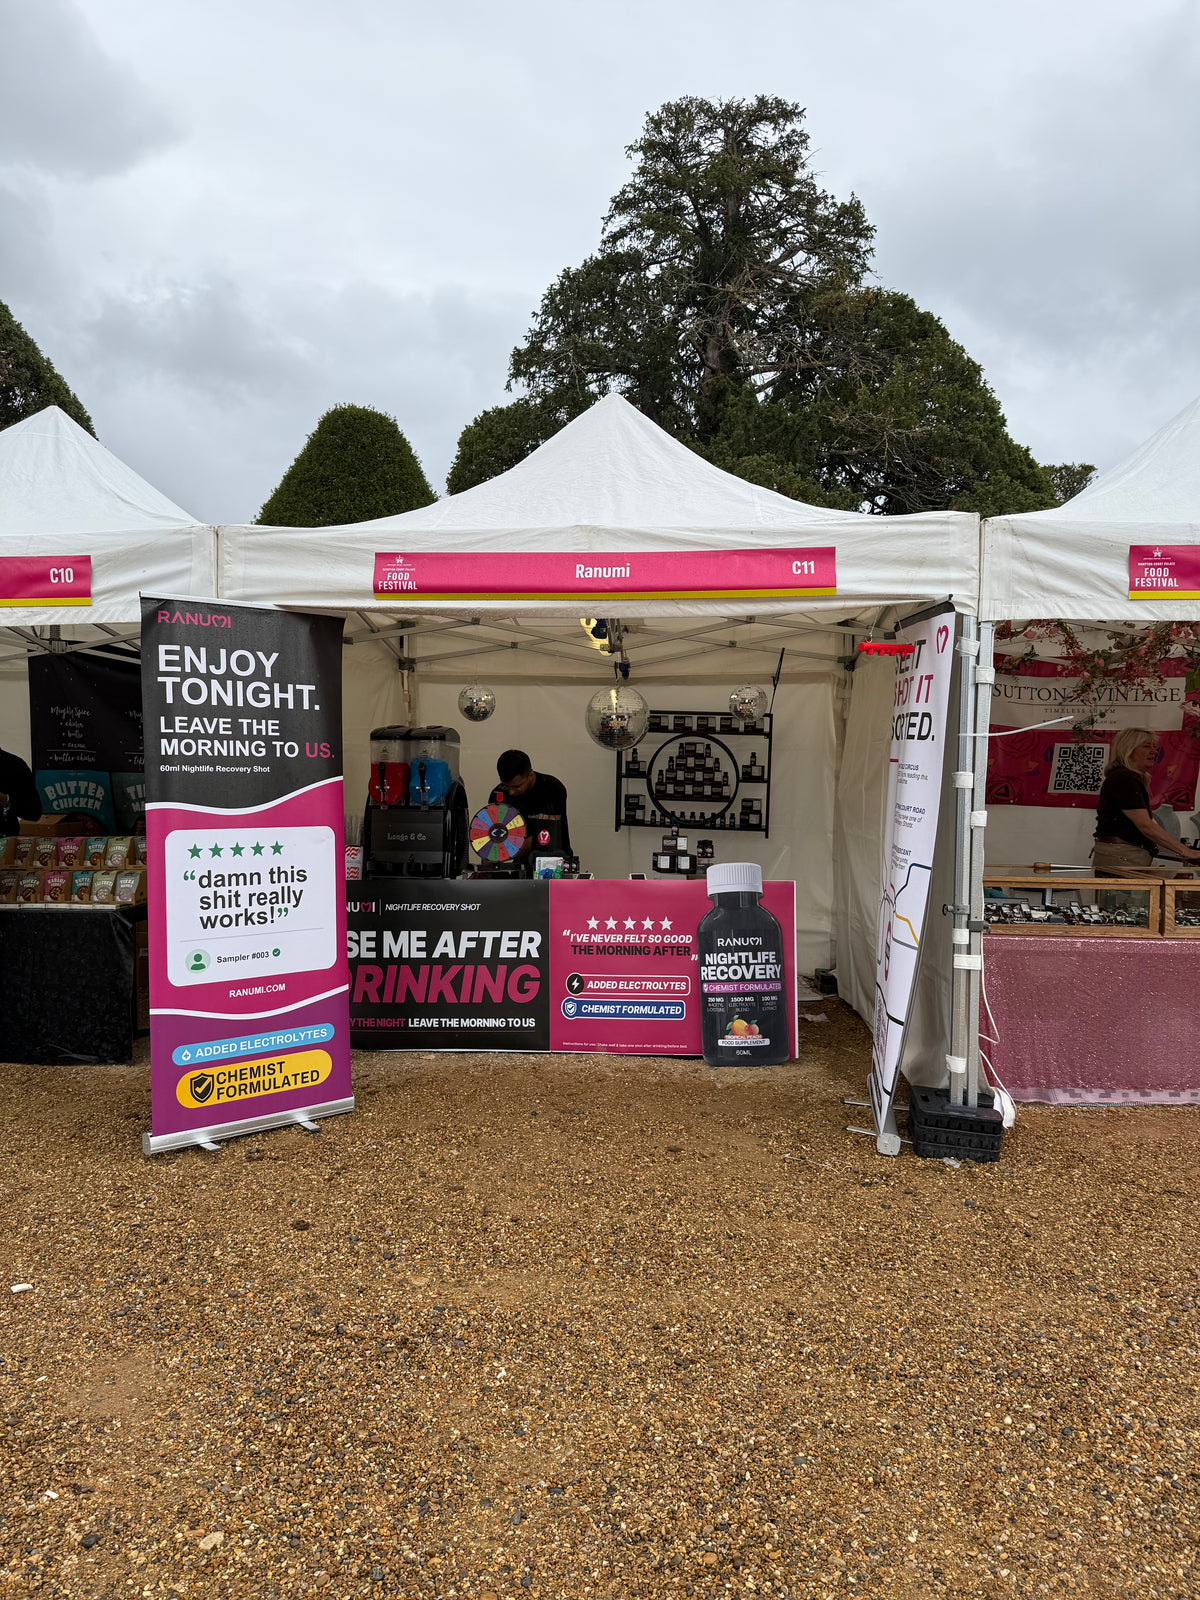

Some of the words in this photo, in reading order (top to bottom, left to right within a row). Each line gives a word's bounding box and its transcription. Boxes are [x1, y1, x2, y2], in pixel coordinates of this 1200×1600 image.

[50, 568, 74, 583] C10
[575, 562, 630, 579] Ranumi
[792, 560, 816, 576] C11
[1144, 568, 1169, 577] FOOD
[387, 572, 410, 580] FOOD
[1135, 578, 1179, 587] FESTIVAL
[378, 581, 418, 590] FESTIVAL
[158, 610, 231, 628] RANUMI
[158, 644, 280, 678] ENJOY
[157, 676, 320, 710] TONIGHT.
[916, 674, 934, 703] IT
[992, 683, 1066, 701] SUTTON
[1095, 687, 1181, 702] VINTAGE
[160, 716, 232, 735] LEAVE
[238, 718, 280, 736] THE
[160, 738, 266, 758] MORNING
[272, 741, 299, 758] TO
[305, 742, 335, 758] US.
[182, 764, 214, 773] Nightlife
[215, 765, 251, 774] Recovery
[44, 780, 105, 800] BUTTER
[52, 798, 103, 810] CHICKEN
[269, 866, 308, 885] this
[200, 890, 241, 911] shit
[248, 886, 303, 909] really
[346, 902, 375, 913] NUMI
[347, 930, 376, 958] SE
[383, 931, 427, 958] ME
[432, 931, 542, 958] AFTER
[590, 934, 623, 943] NEVER
[624, 934, 647, 943] FELT
[648, 935, 661, 943] SO
[663, 935, 693, 943] GOOD
[717, 937, 762, 946] RANUMI
[217, 953, 250, 964] Sampler
[251, 951, 270, 960] #003
[571, 945, 594, 955] THE
[596, 945, 651, 956] MORNING
[705, 952, 776, 965] NIGHTLIFE
[701, 964, 781, 980] RECOVERY
[229, 983, 286, 998] RANUMI.COM
[349, 964, 541, 1004] RINKING
[587, 981, 618, 989] ADDED
[618, 981, 686, 990] ELECTROLYTES
[740, 983, 781, 991] FORMULATED
[581, 1005, 622, 1014] CHEMIST
[622, 1005, 682, 1014] FORMULATED
[357, 1019, 375, 1027] THE
[376, 1018, 406, 1027] NIGHT
[408, 1018, 439, 1027] LEAVE
[440, 1018, 459, 1027] THE
[461, 1018, 506, 1027] MORNING
[508, 1018, 521, 1027] TO
[522, 1018, 536, 1027] US
[195, 1044, 236, 1058] ADDED
[240, 1028, 327, 1050] ELECTROLYTES
[216, 1061, 286, 1085] CHEMIST
[217, 1070, 320, 1101] FORMULATED
